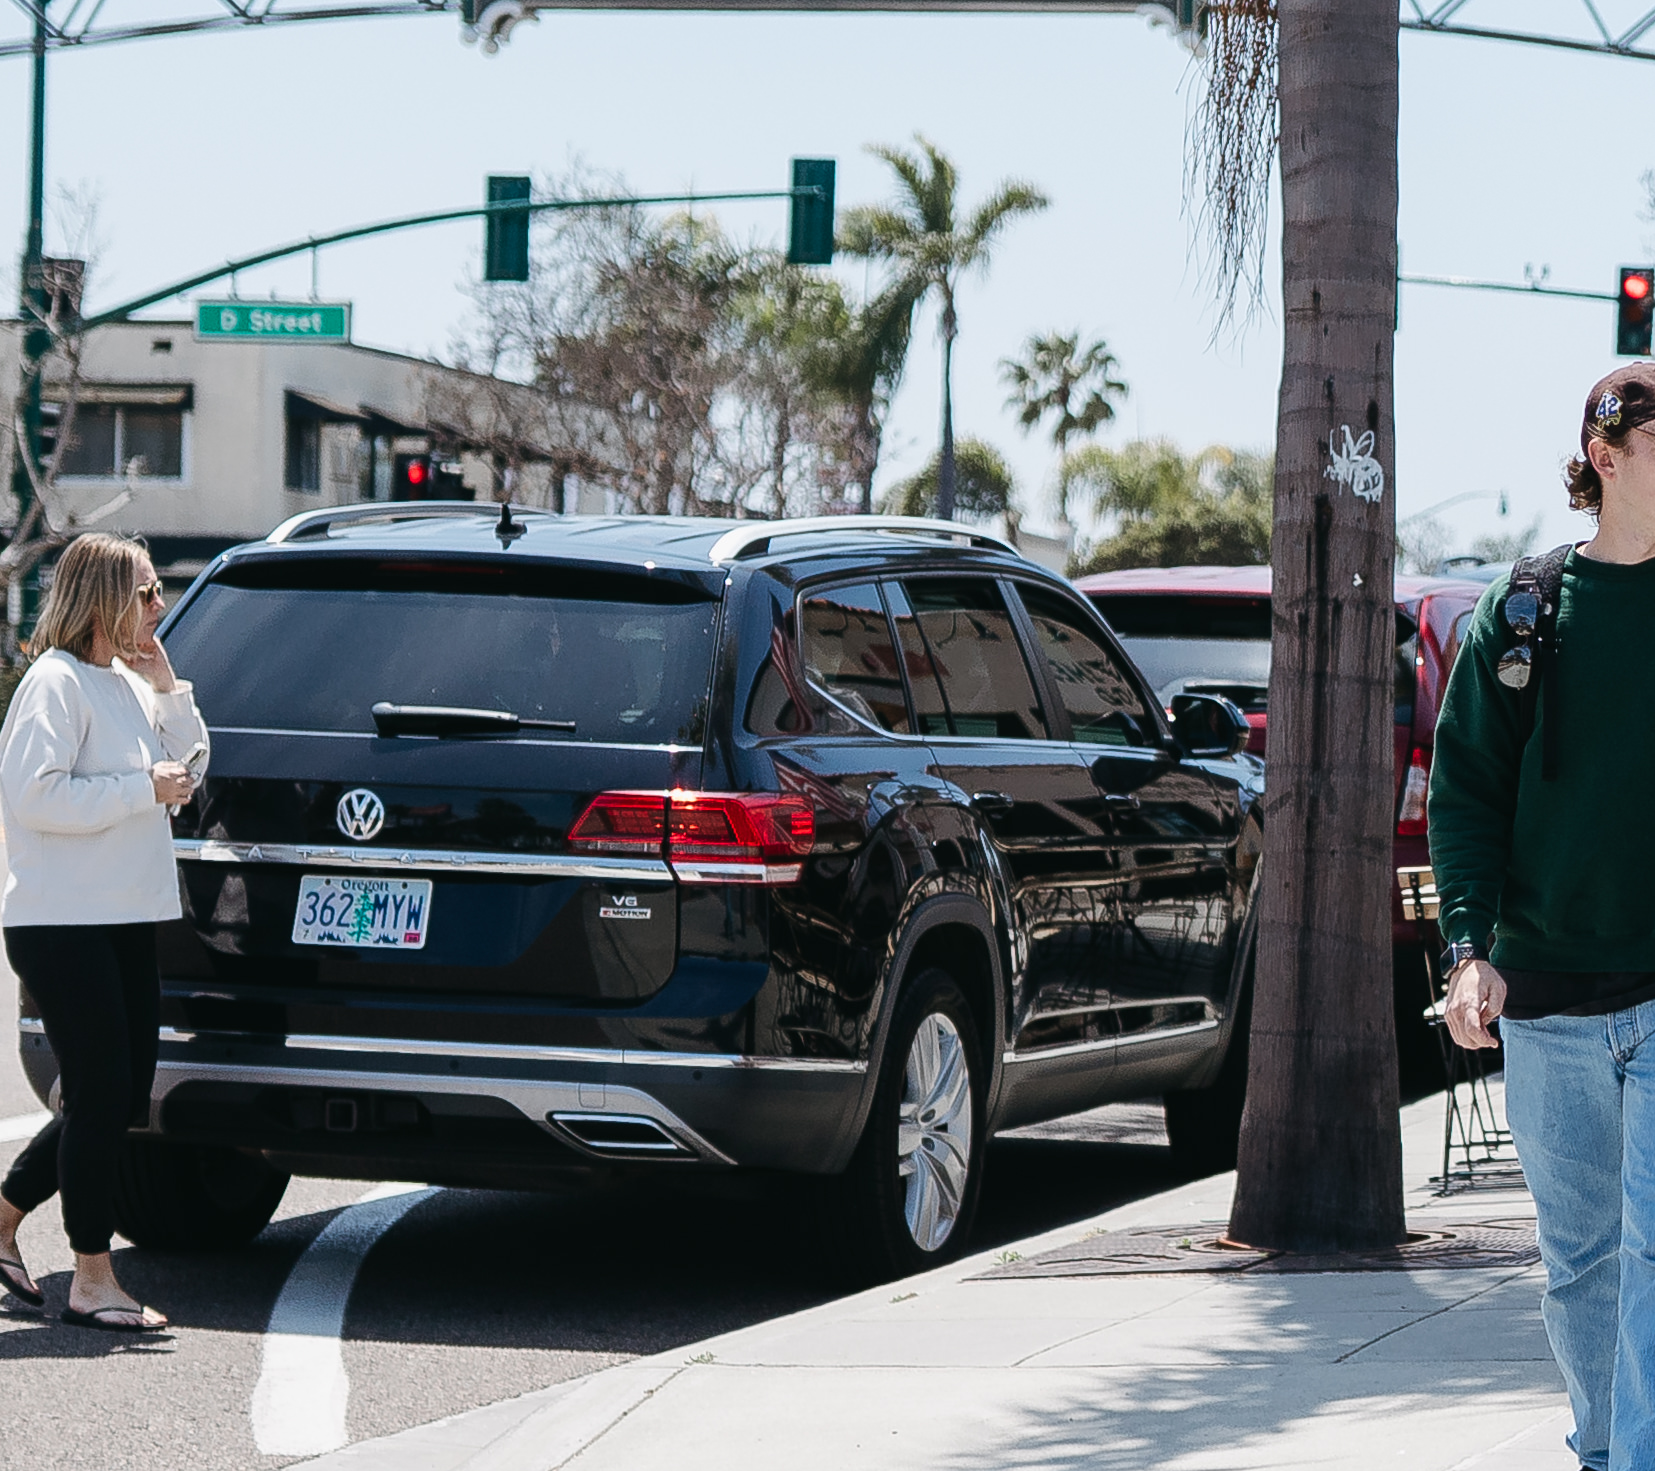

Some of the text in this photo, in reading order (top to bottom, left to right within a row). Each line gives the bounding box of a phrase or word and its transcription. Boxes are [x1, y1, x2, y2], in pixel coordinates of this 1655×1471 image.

[221, 309, 322, 333] D Street
[1597, 395, 1619, 418] 42
[341, 879, 389, 892] Oregon
[302, 892, 423, 930] 362 MYW
